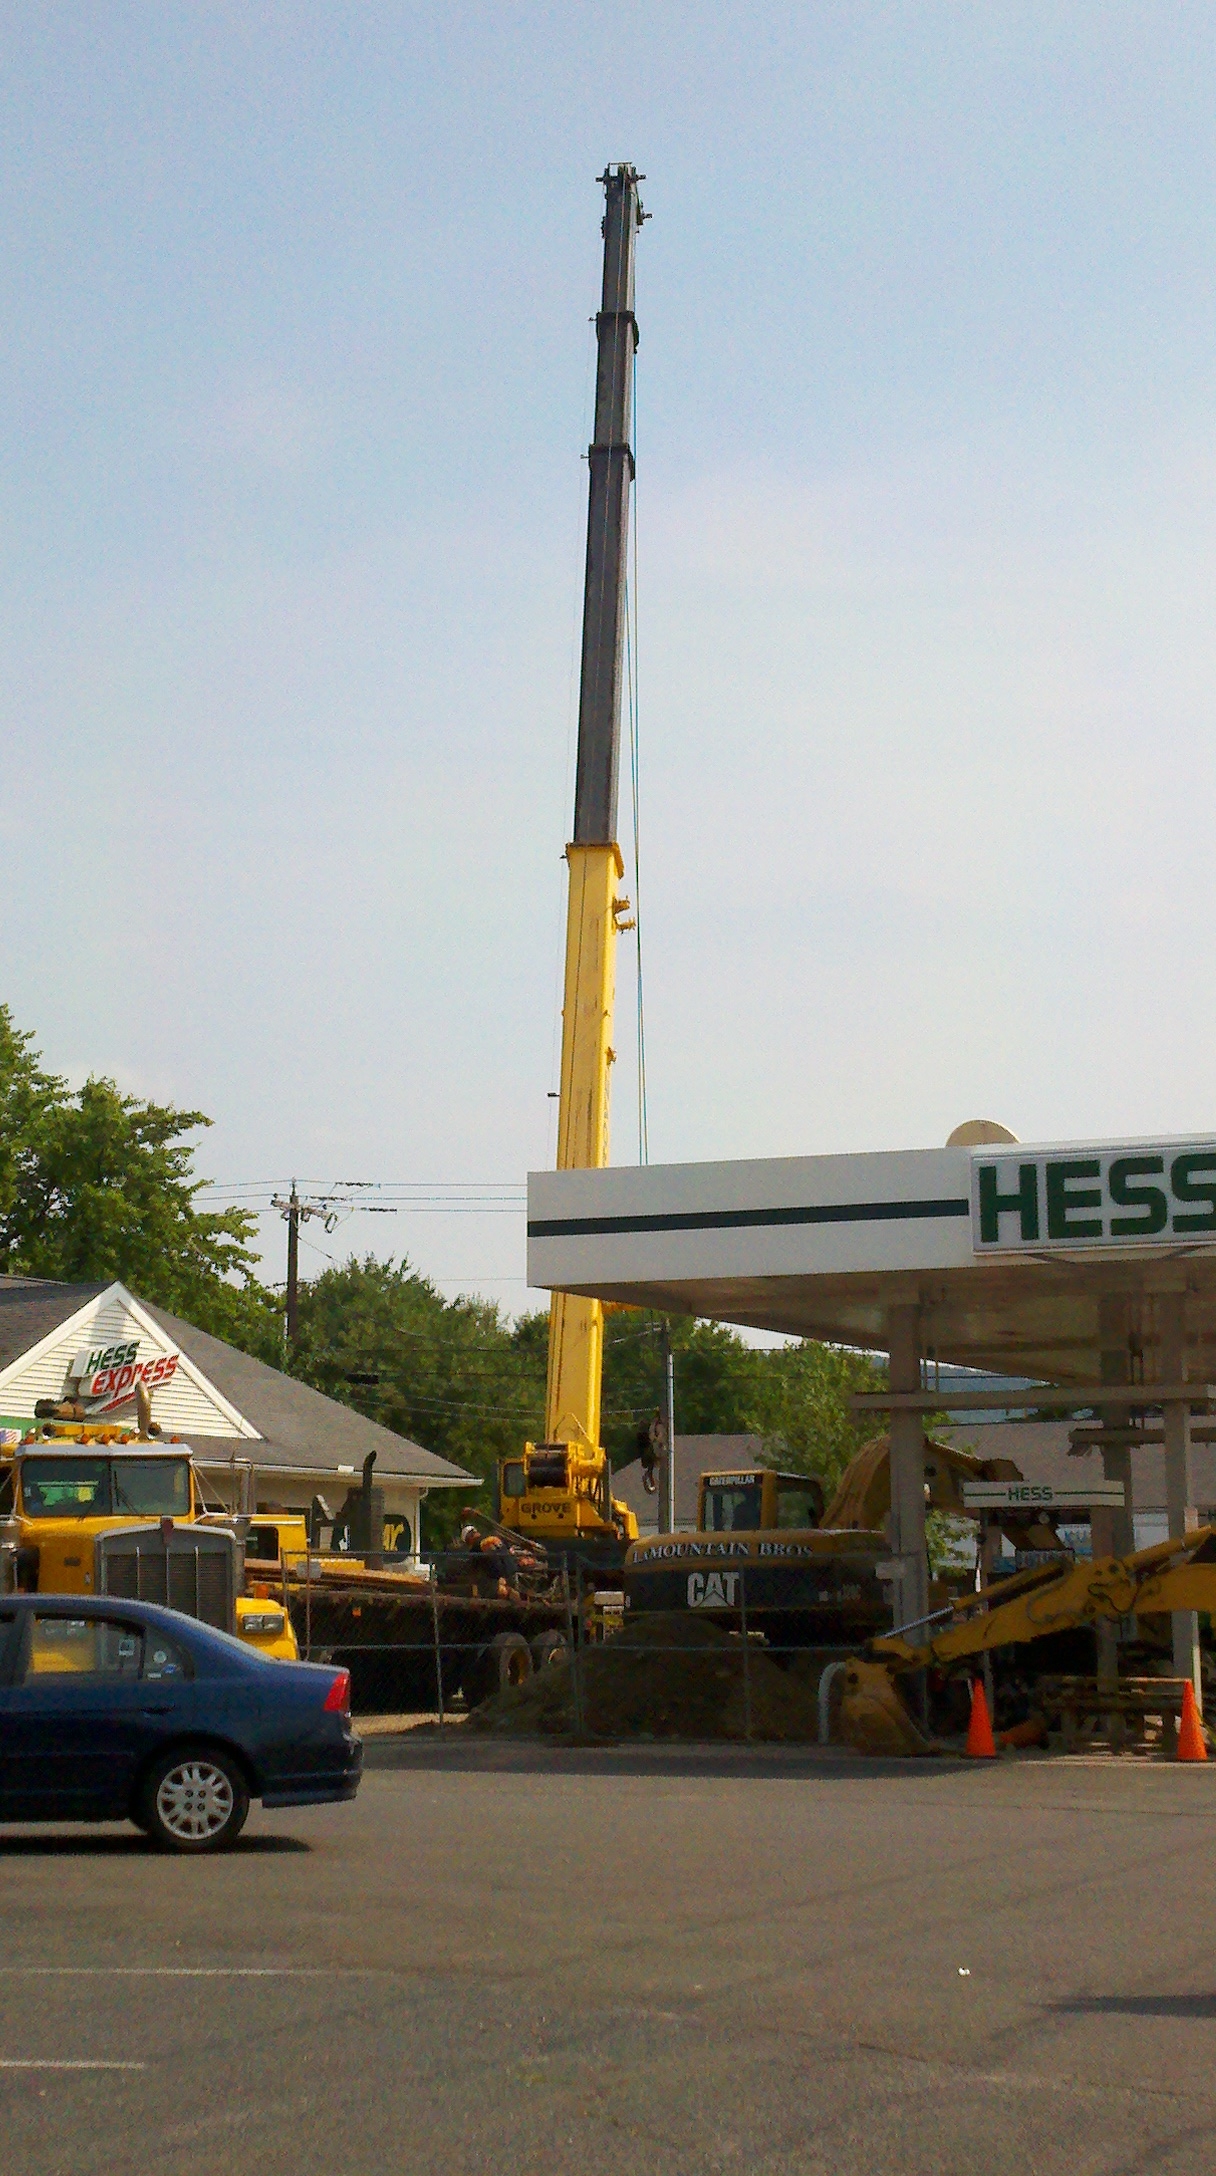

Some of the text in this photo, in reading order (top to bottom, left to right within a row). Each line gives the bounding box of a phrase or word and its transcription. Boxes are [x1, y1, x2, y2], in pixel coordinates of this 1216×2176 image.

[979, 1153, 1216, 1243] HESS
[86, 1341, 140, 1374] HESS
[521, 1502, 571, 1513] GROVE
[1008, 1487, 1053, 1501] HESS
[687, 1571, 740, 1607] CAT
